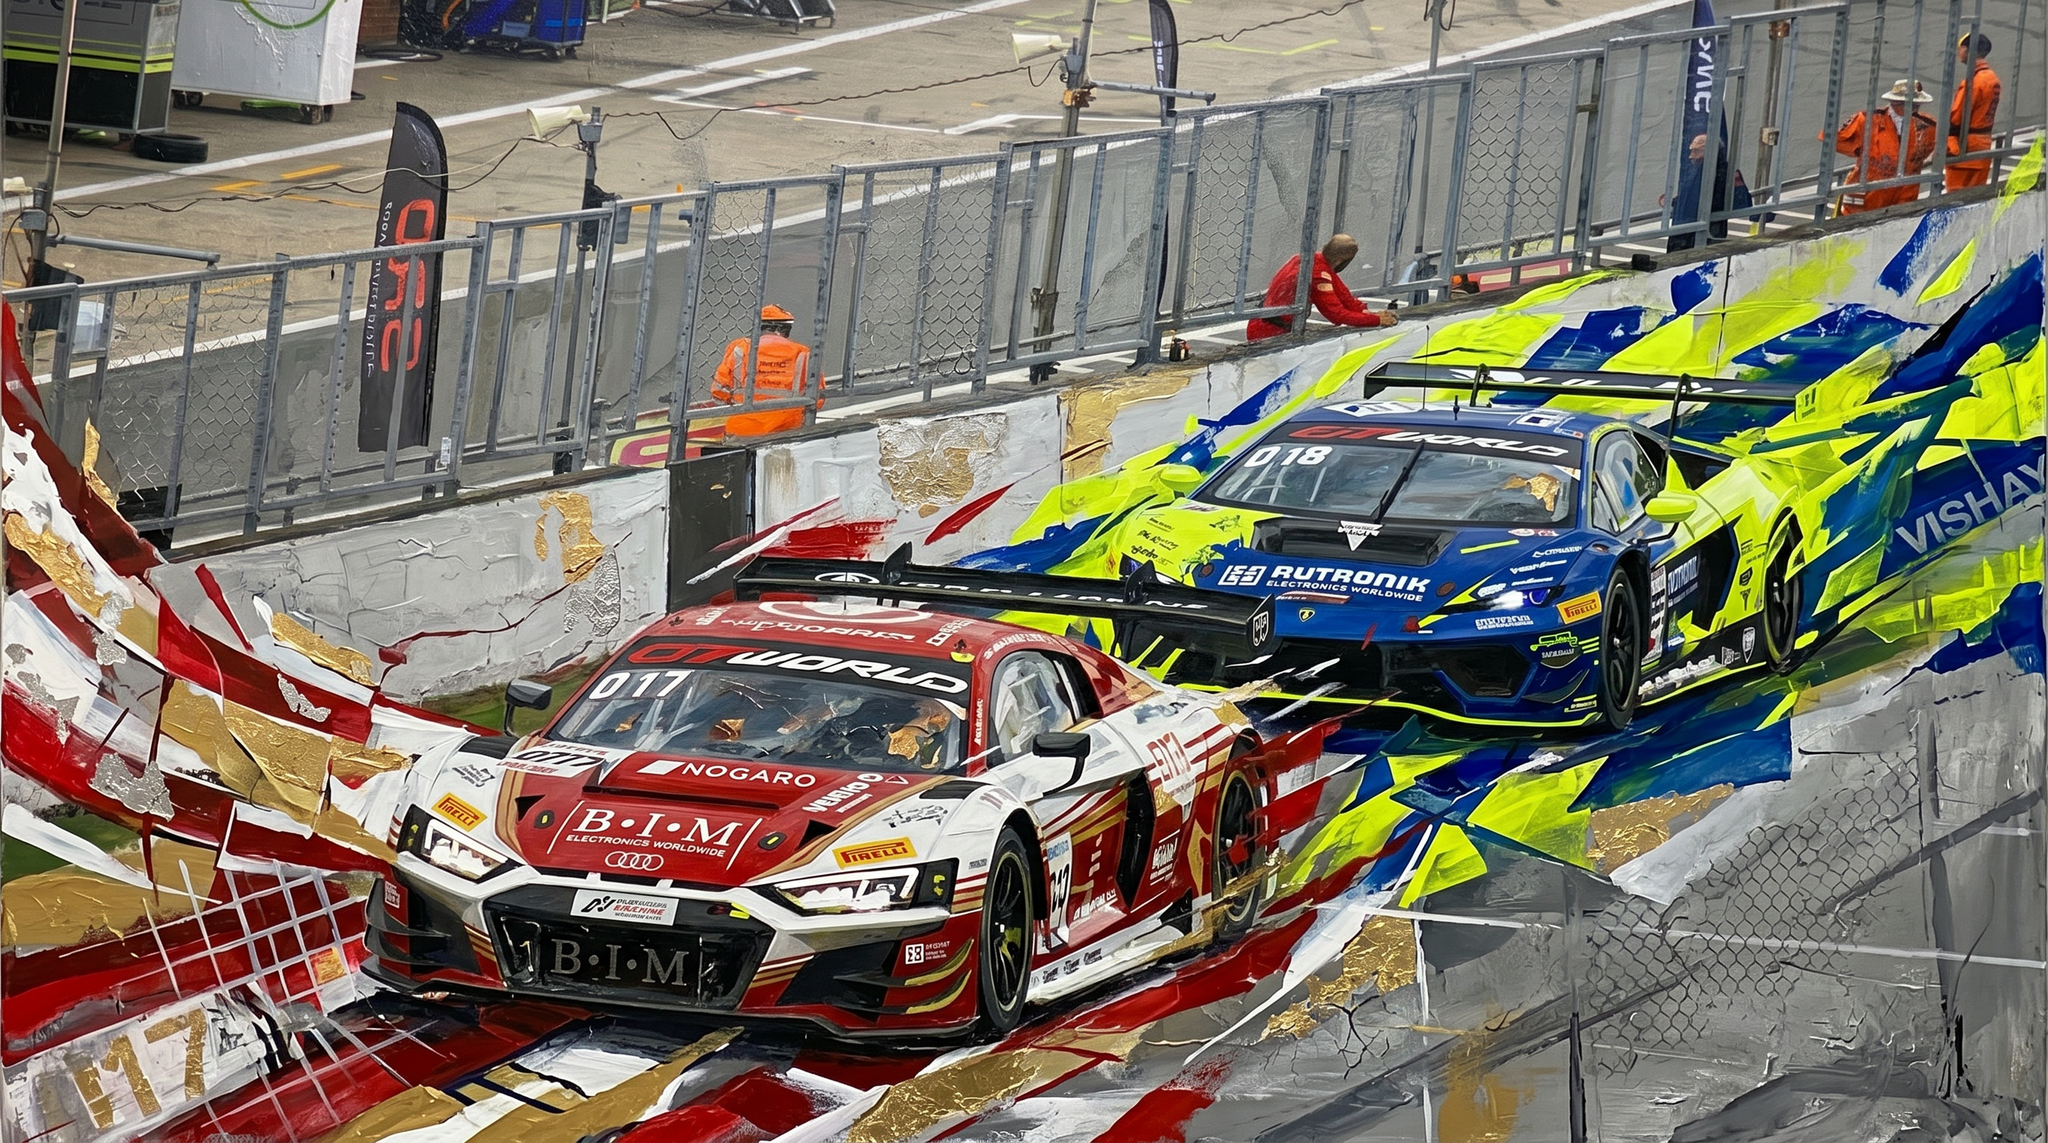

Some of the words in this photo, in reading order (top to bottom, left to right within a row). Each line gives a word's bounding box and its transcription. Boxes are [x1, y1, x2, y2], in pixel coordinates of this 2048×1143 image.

[1895, 453, 2045, 554] VISHAY
[1266, 580, 1348, 592] ELECTRONICS
[1351, 586, 1424, 602] WORLDWIDE
[1270, 565, 1431, 593] RUTRONIK
[726, 651, 969, 694] WORLD
[681, 762, 816, 788] NOGARO
[565, 834, 651, 848] ELECTRONICS
[653, 841, 727, 858] WORLDWIDE
[840, 841, 909, 864] PIRELLI
